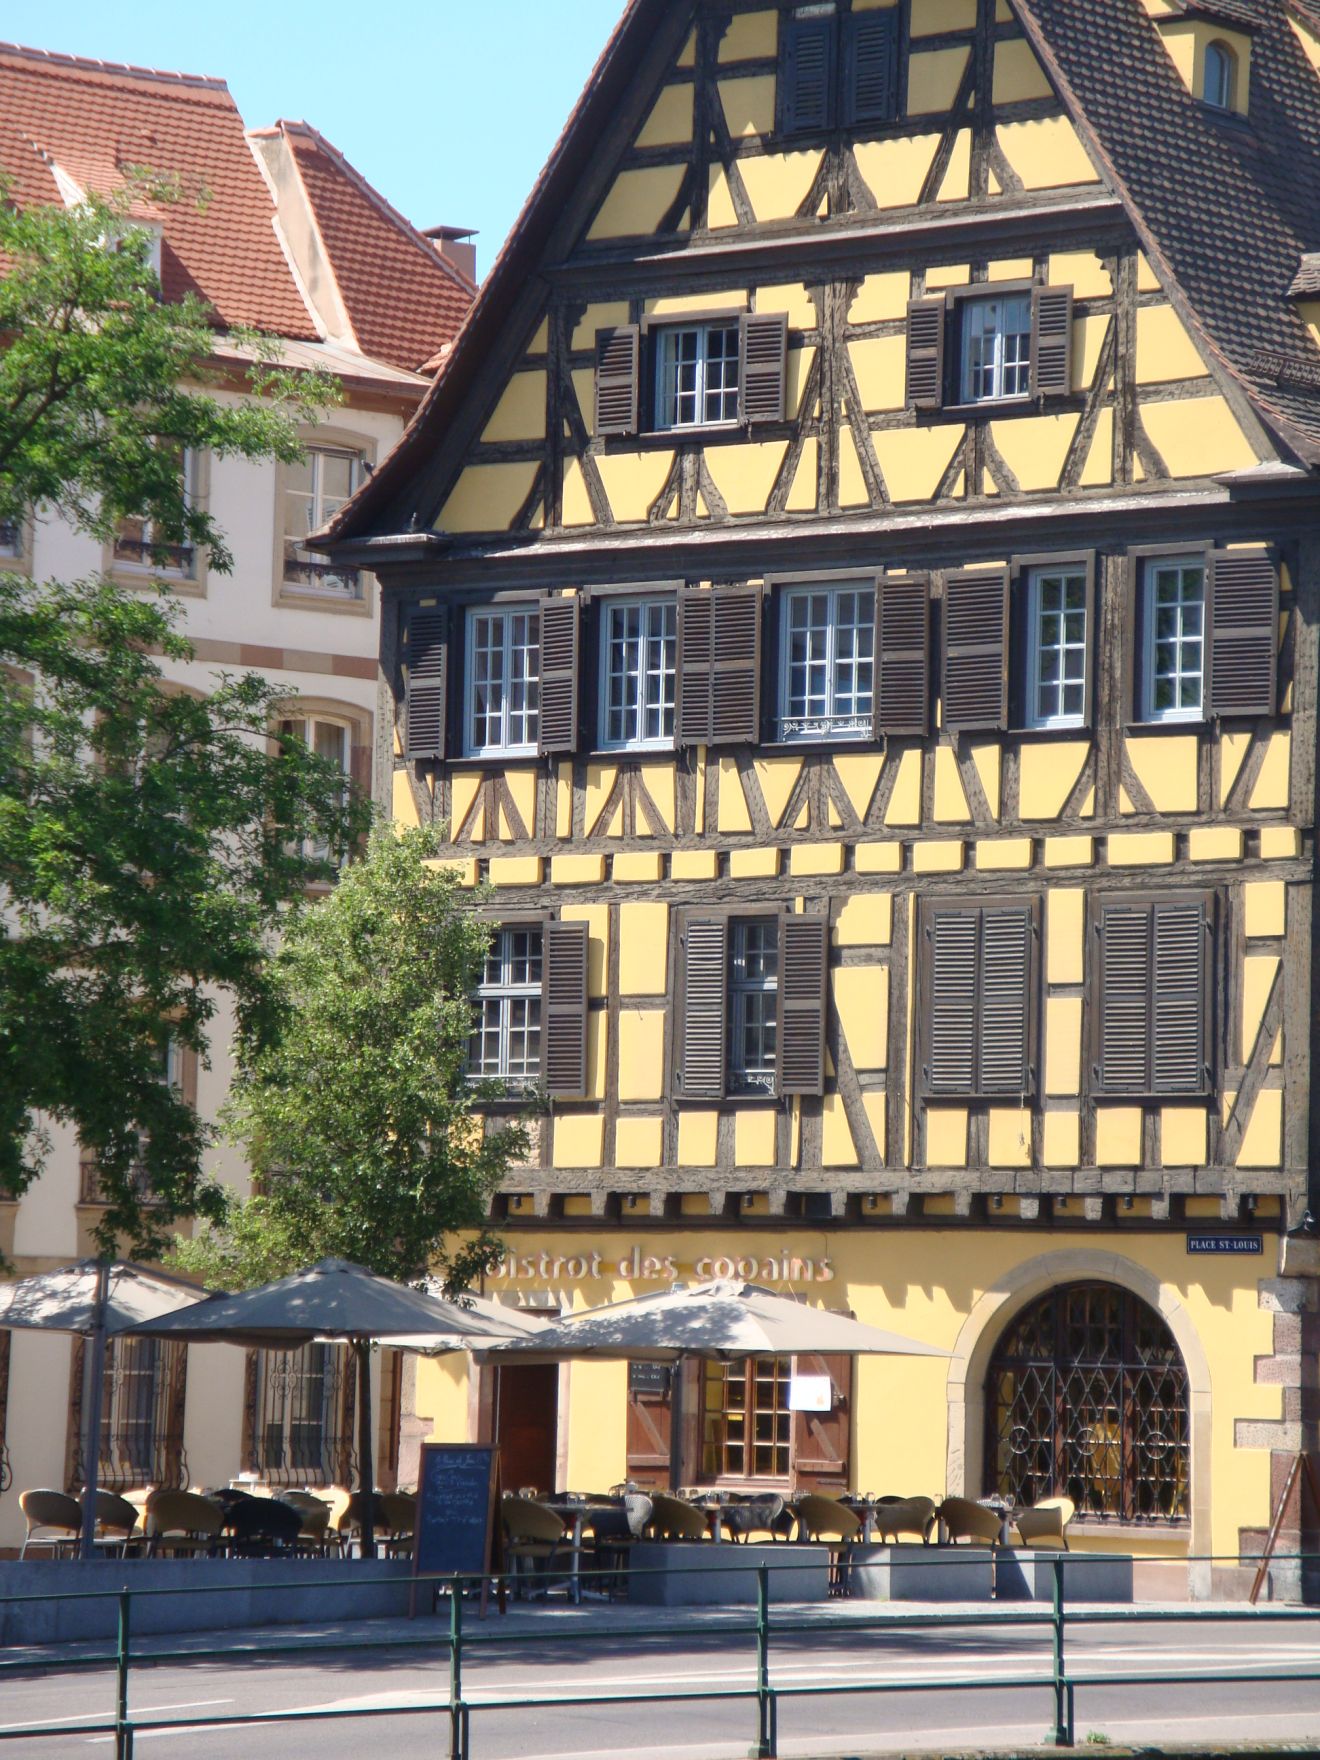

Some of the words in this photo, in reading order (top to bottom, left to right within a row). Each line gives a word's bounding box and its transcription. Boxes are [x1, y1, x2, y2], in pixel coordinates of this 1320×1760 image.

[1190, 1240, 1216, 1249] PLACE
[618, 1245, 679, 1280] des
[695, 1248, 835, 1281] copains
